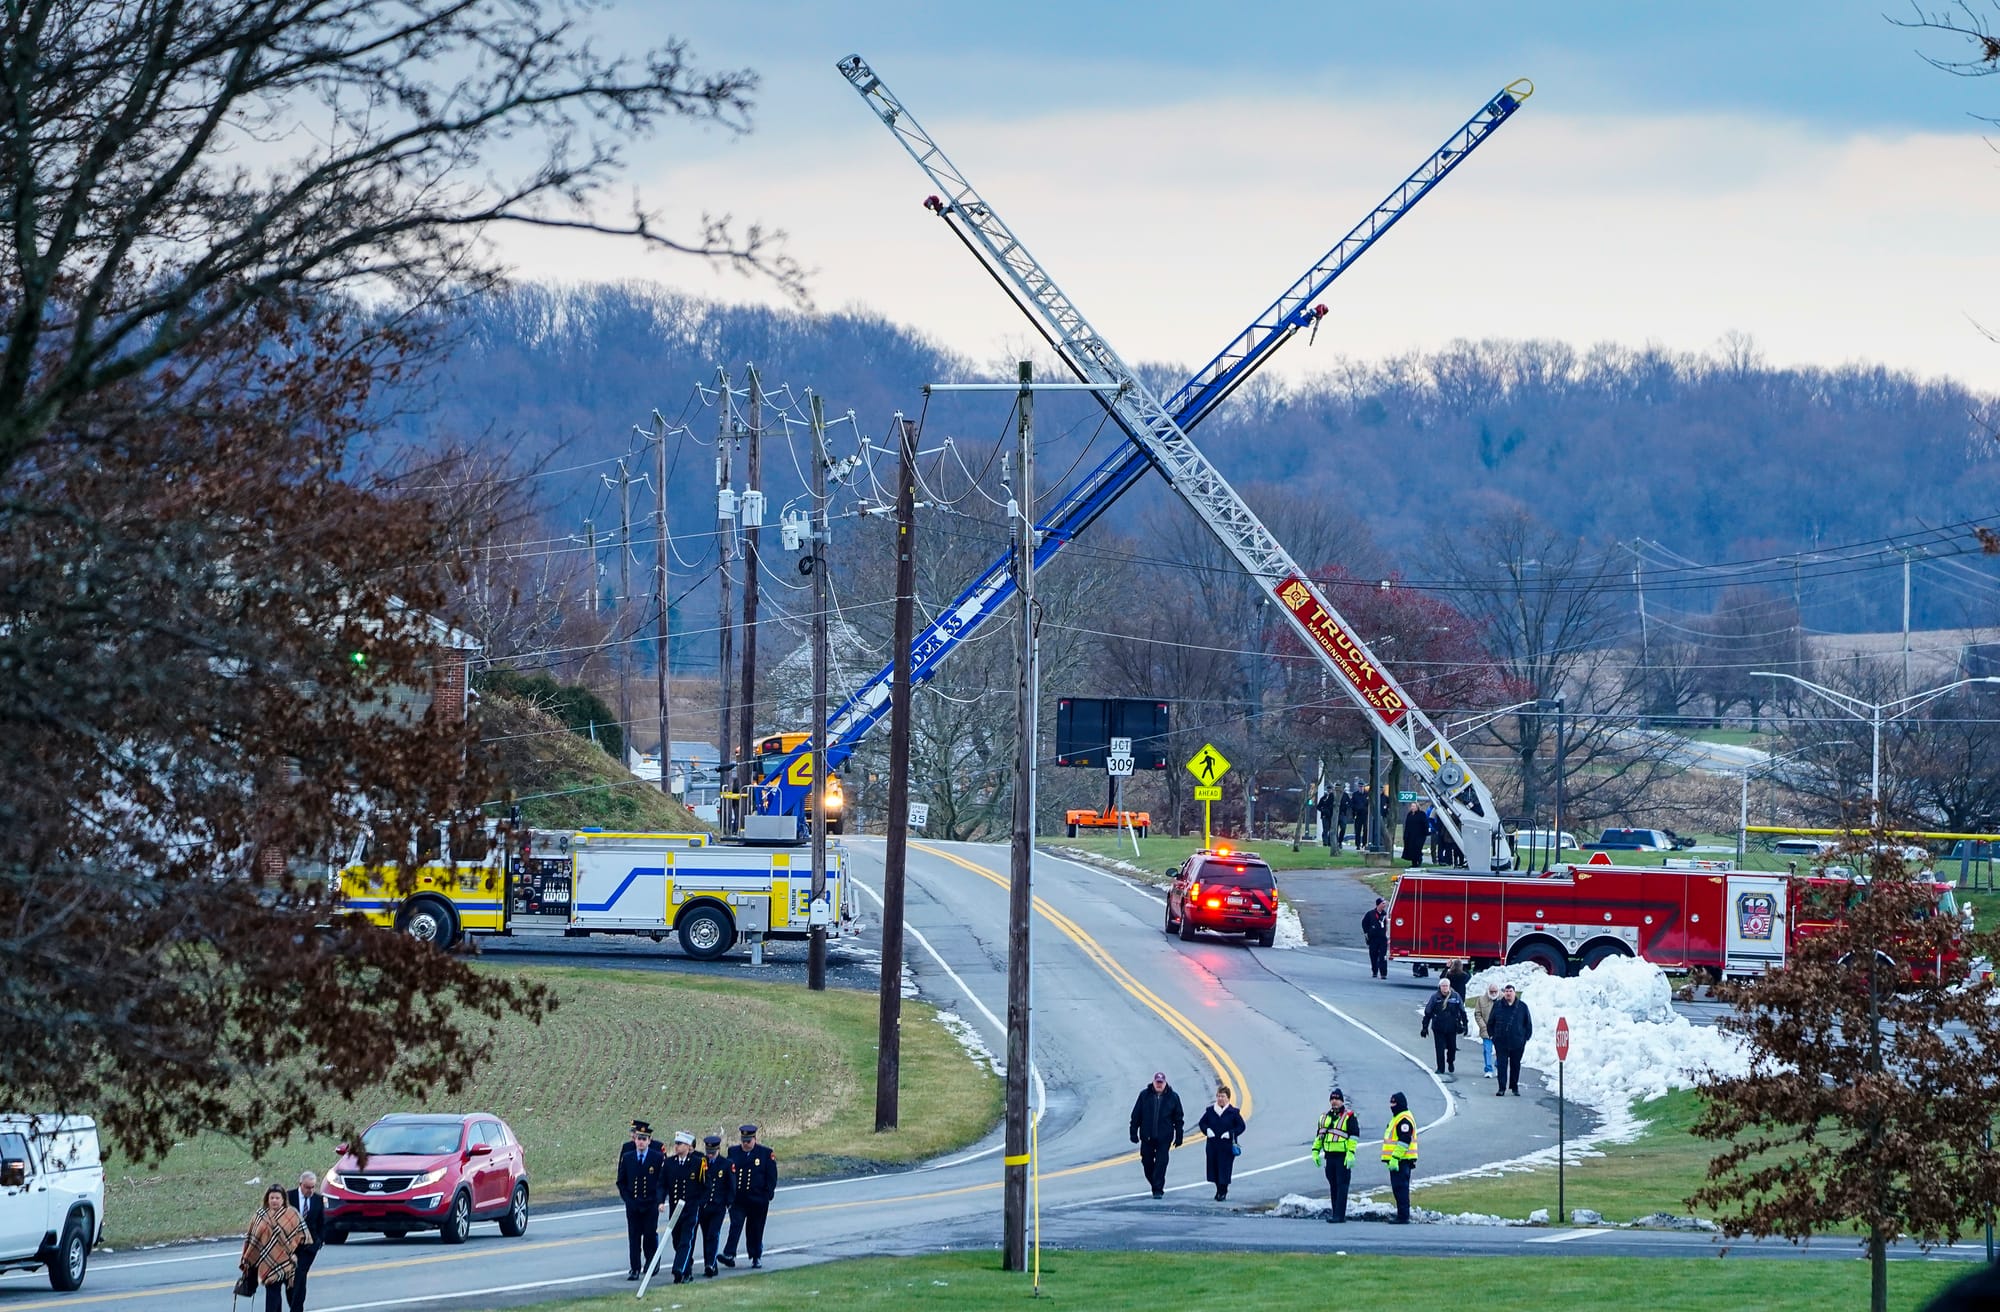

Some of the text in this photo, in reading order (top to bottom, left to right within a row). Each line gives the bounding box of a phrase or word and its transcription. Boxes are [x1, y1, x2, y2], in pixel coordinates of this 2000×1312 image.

[1310, 604, 1402, 714] TRUCK 12
[1363, 686, 1381, 707] TWP
[1112, 741, 1130, 750] JCT
[1110, 758, 1133, 771] 309
[910, 814, 925, 823] 35
[1745, 898, 1768, 914] 12
[1432, 934, 1455, 950] 12
[1556, 1030, 1569, 1047] STOP
